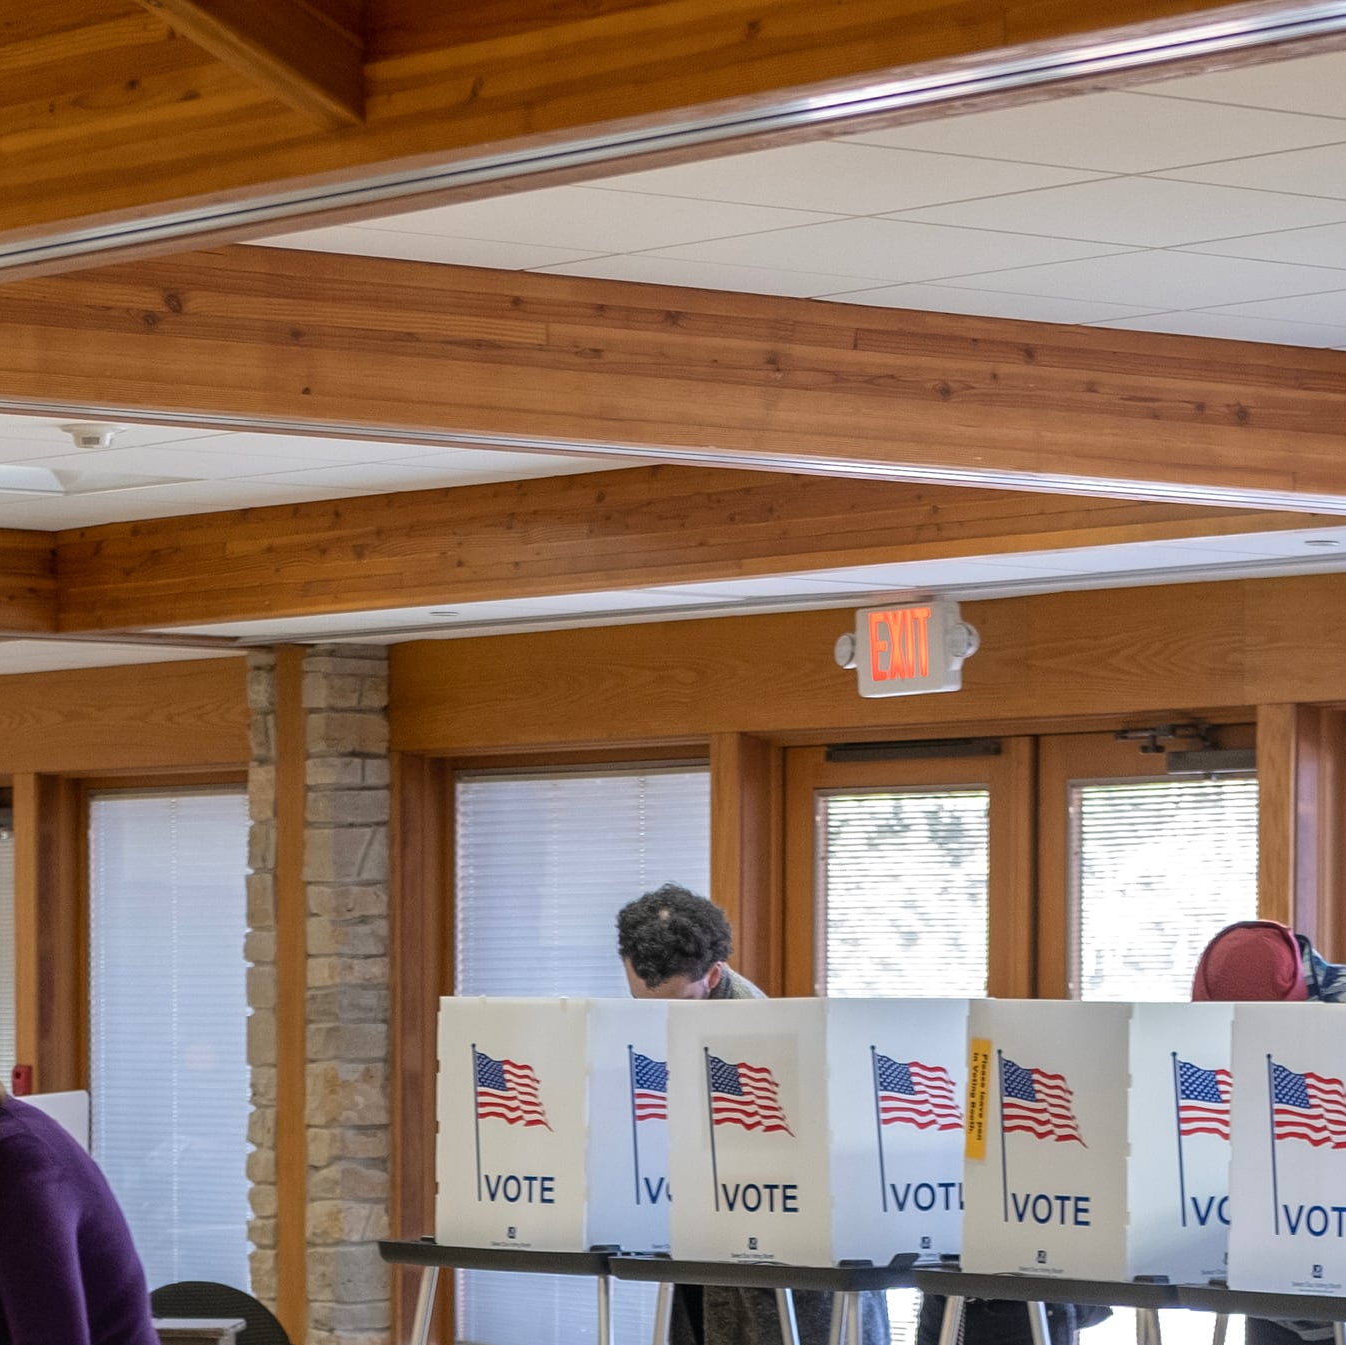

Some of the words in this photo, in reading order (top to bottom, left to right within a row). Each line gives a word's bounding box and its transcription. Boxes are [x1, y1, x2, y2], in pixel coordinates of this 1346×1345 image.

[869, 608, 930, 681] EXIT
[485, 1175, 554, 1203] VOTE
[722, 1184, 798, 1212] VOTE
[1012, 1193, 1090, 1226] VOTE
